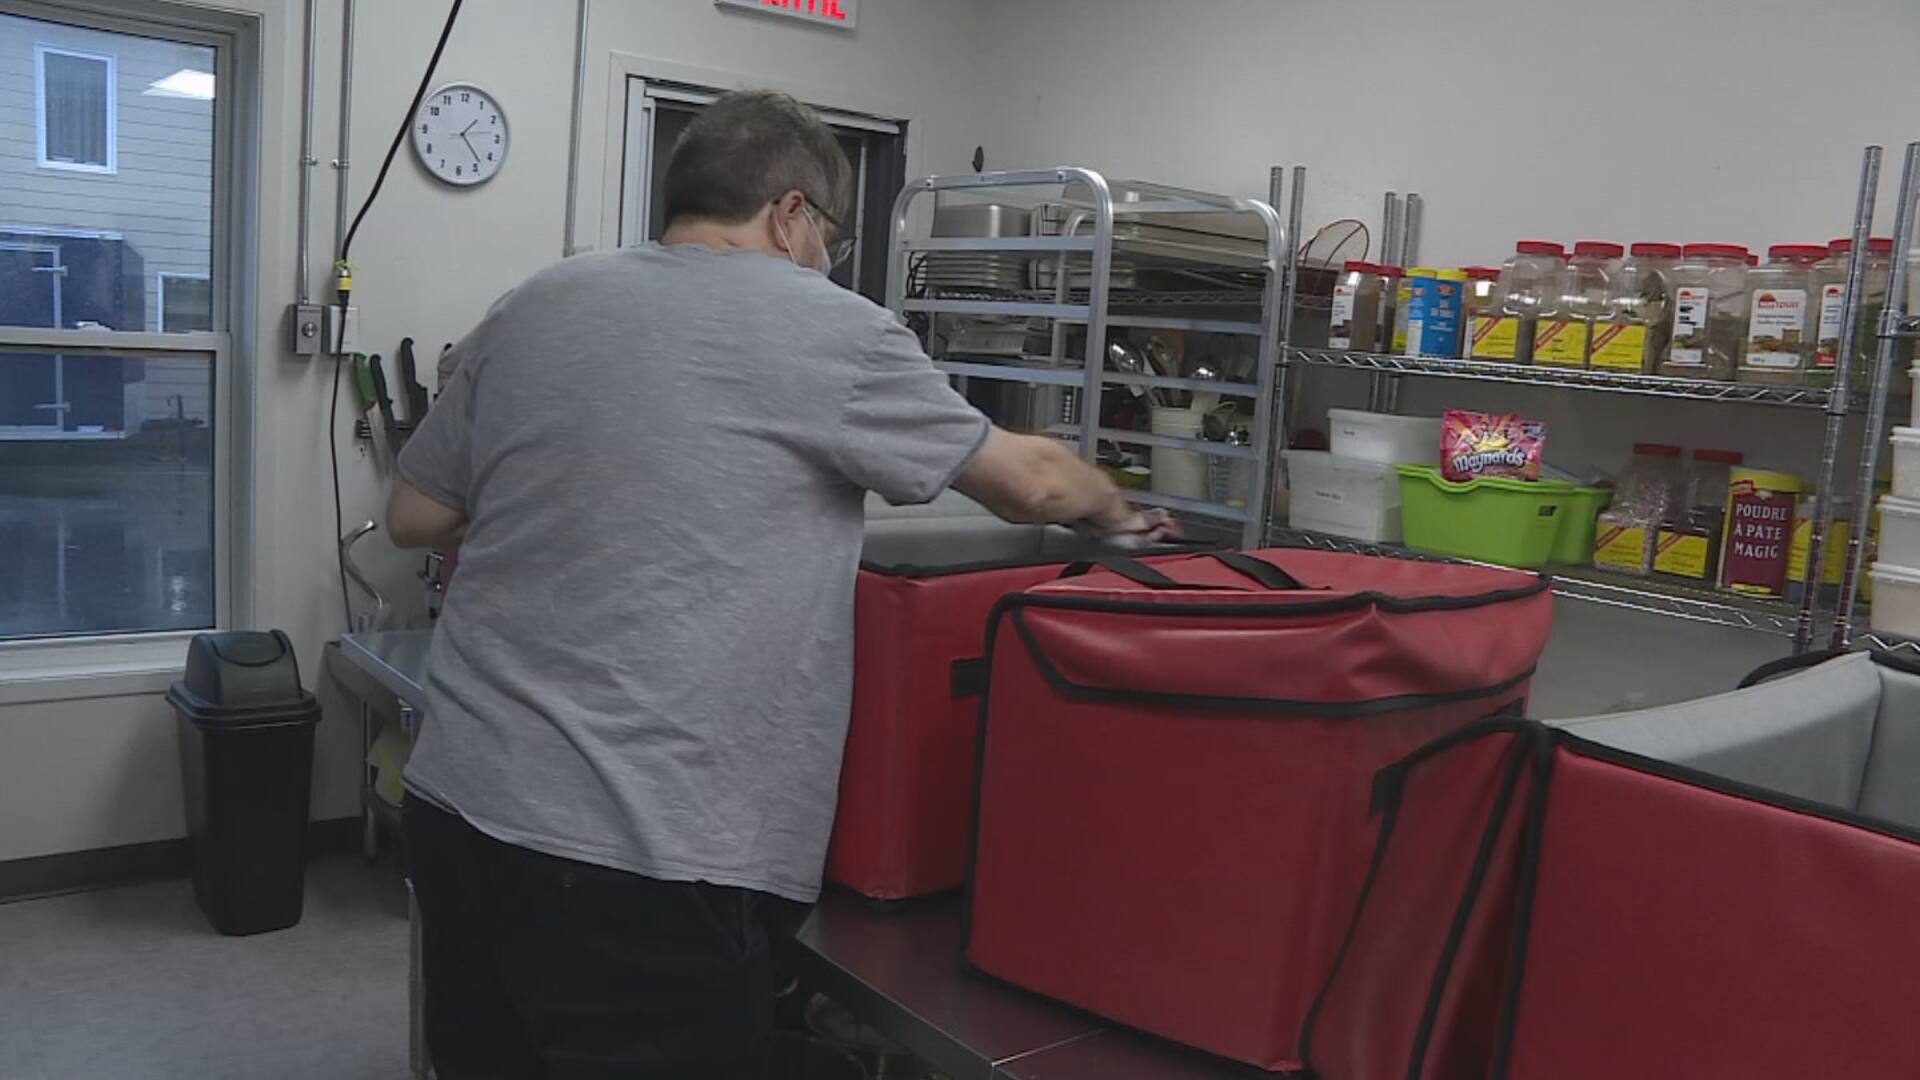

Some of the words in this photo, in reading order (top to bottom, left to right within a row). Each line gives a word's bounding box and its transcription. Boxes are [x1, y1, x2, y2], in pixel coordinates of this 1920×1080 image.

[460, 92, 471, 103] 12
[479, 100, 485, 111] 1
[430, 106, 440, 117] 10
[490, 115, 497, 125] 2
[1735, 503, 1787, 521] POUDRE
[1733, 541, 1779, 559] MAGIC
